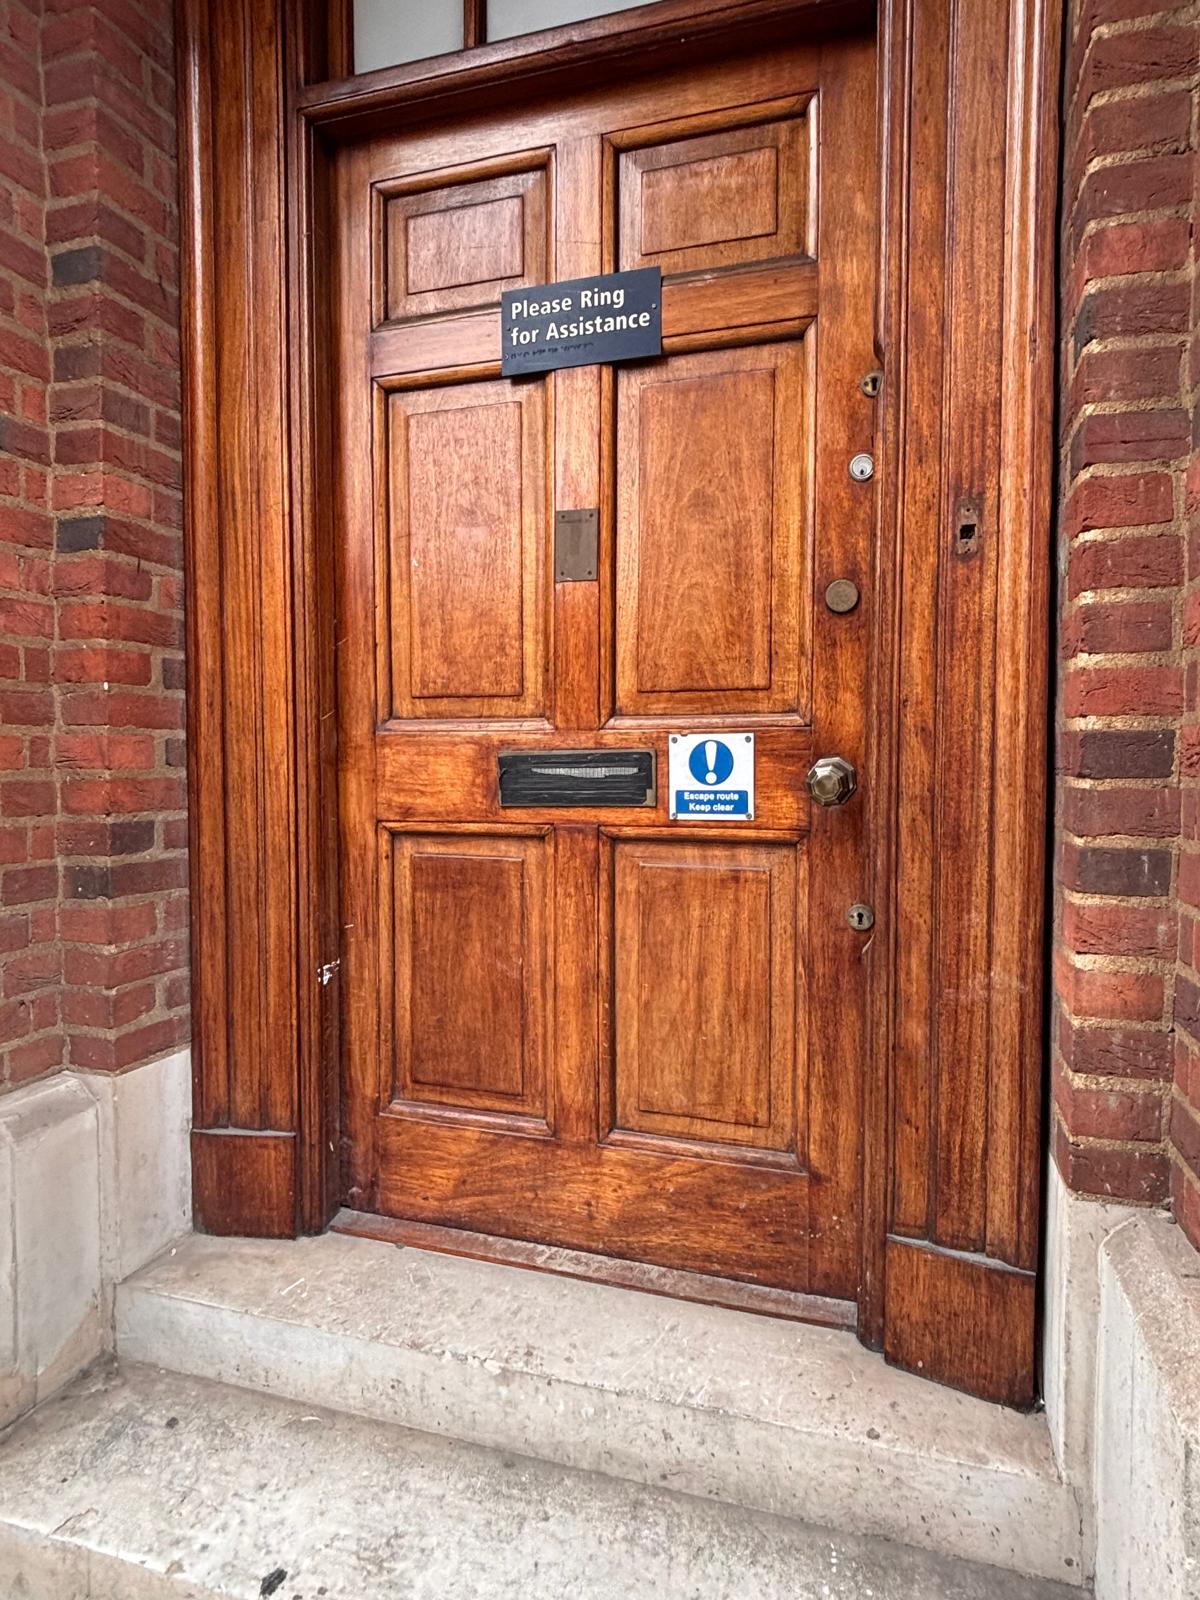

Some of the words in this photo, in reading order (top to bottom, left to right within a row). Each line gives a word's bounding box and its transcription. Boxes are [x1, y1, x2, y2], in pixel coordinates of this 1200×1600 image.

[511, 297, 572, 320] Please
[580, 287, 625, 309] Ring
[511, 327, 539, 346] for
[546, 311, 651, 341] Assistance
[684, 791, 715, 802] Escape
[716, 792, 740, 801] route
[689, 802, 711, 812] Keep
[712, 802, 735, 811] clear
